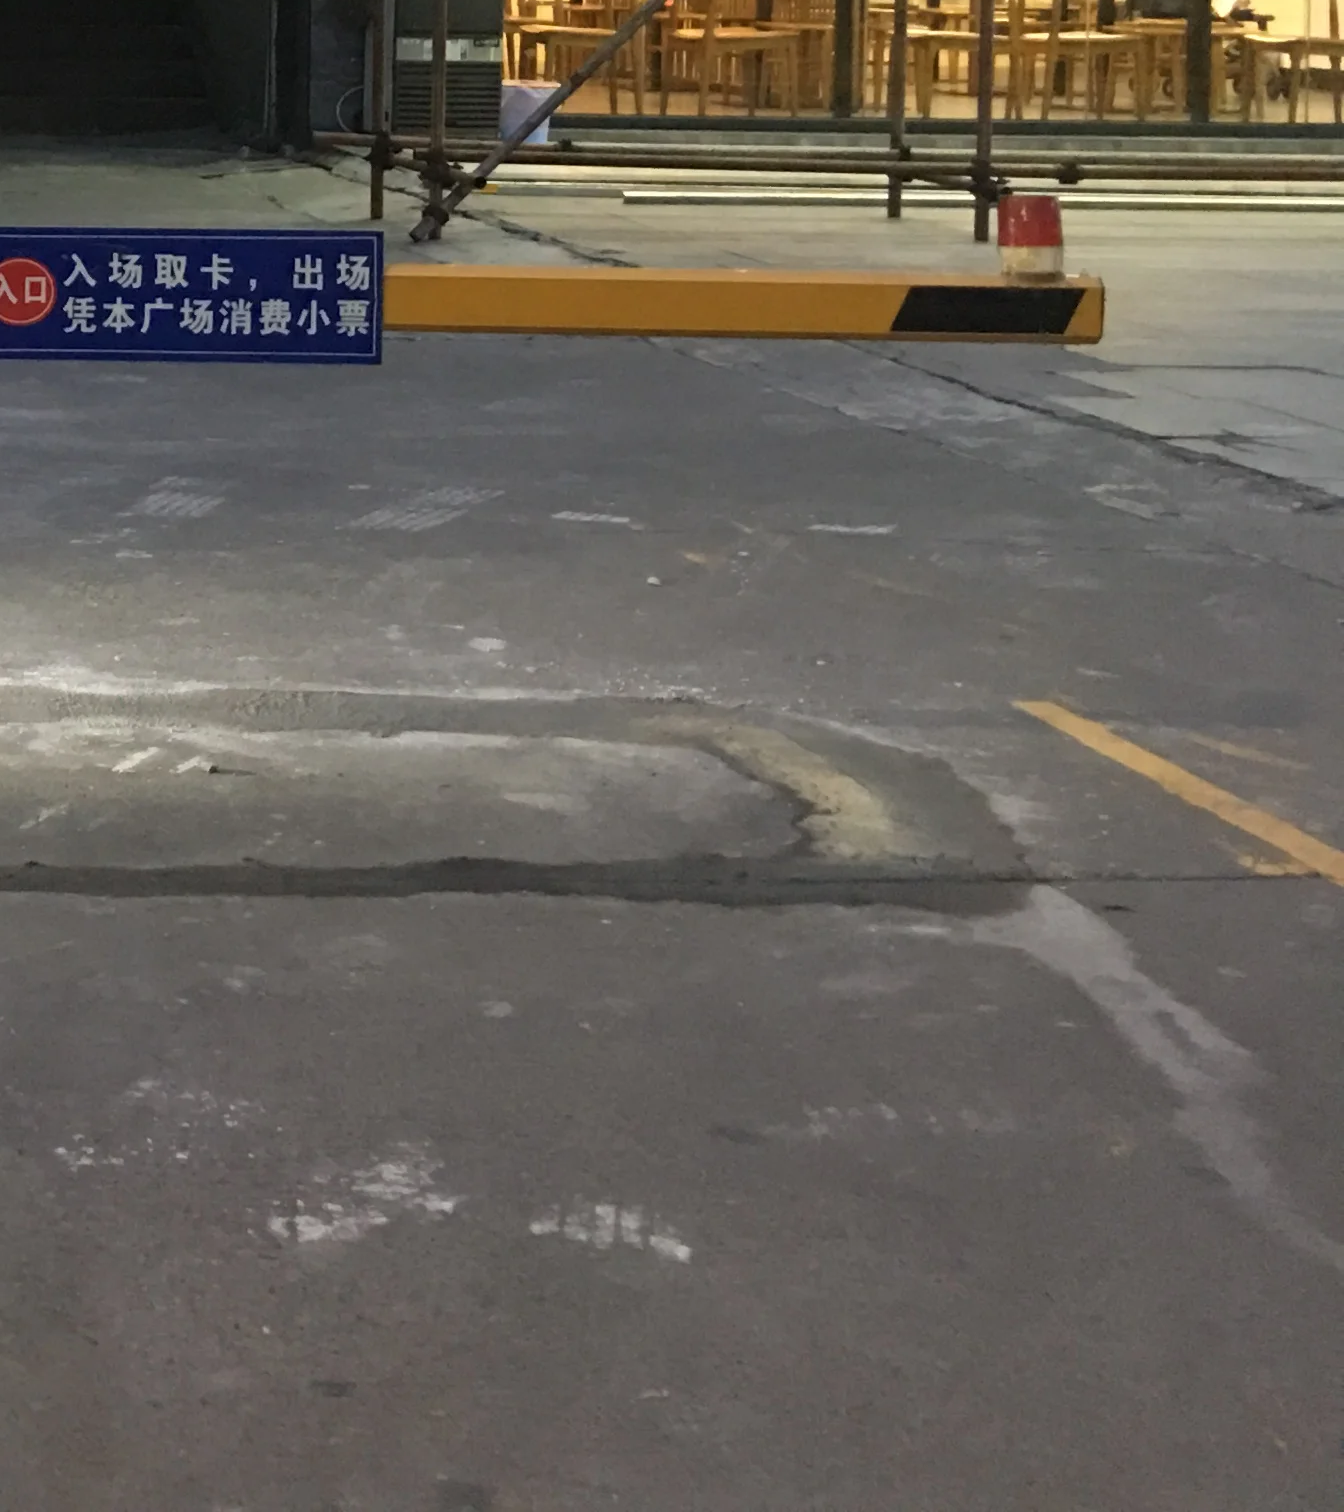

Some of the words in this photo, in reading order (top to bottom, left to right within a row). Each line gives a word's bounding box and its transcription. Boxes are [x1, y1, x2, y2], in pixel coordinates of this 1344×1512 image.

[62, 296, 372, 338] 凭本广场消费小票
